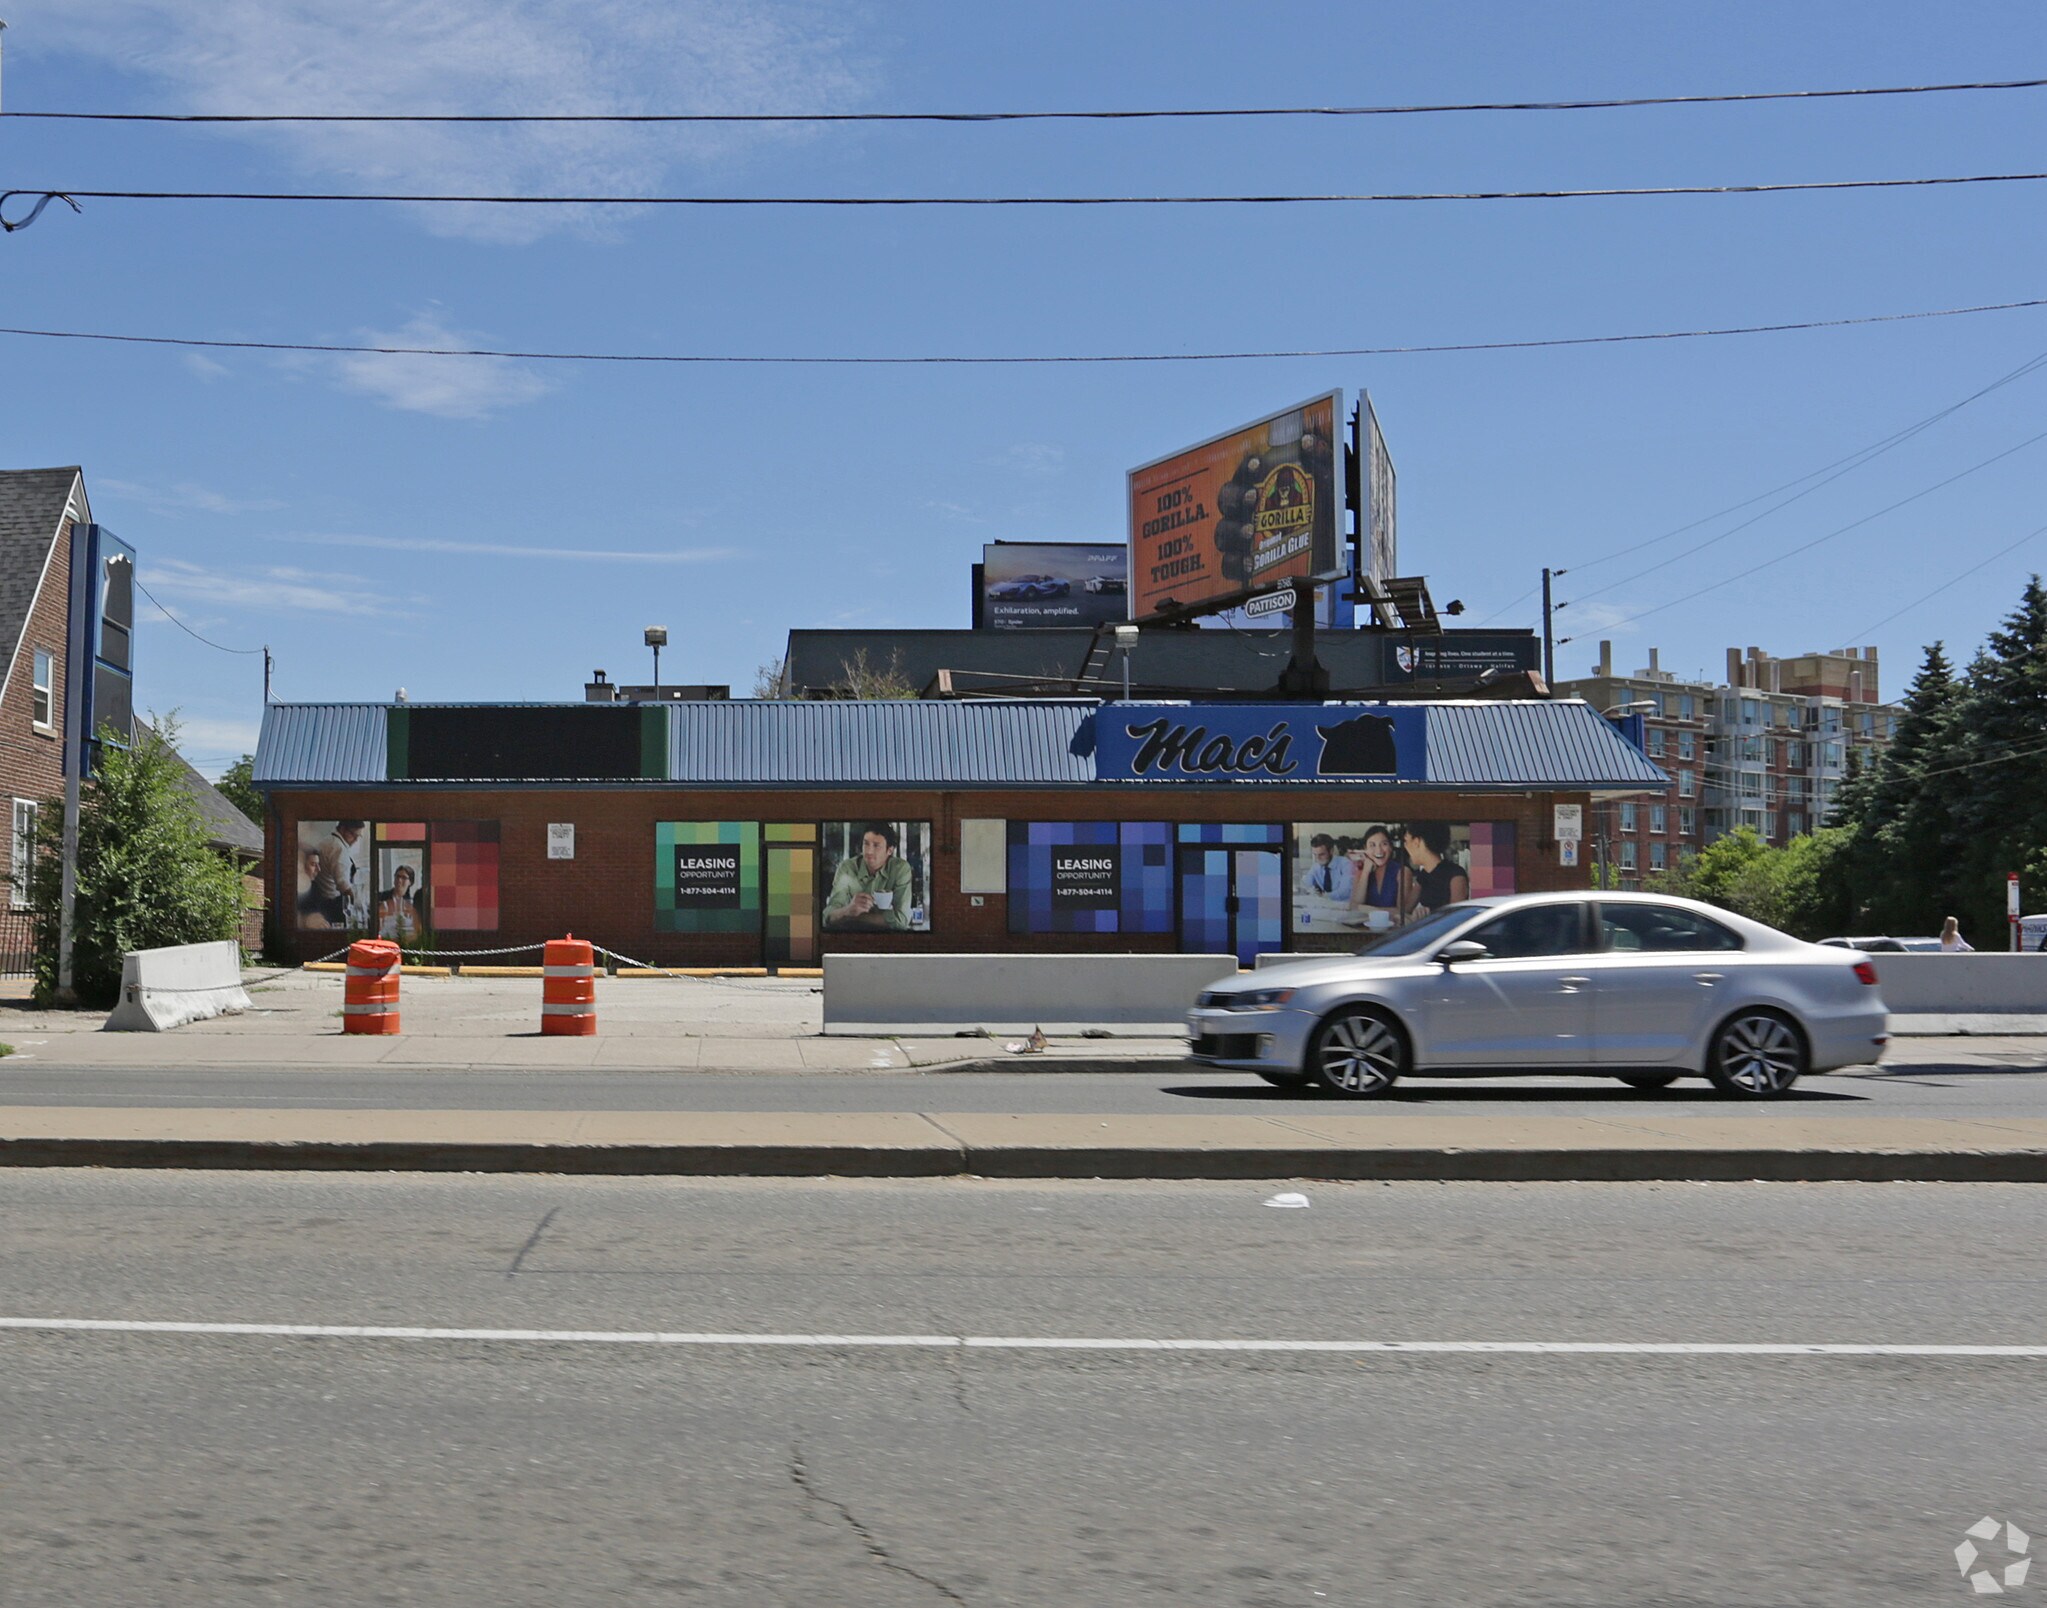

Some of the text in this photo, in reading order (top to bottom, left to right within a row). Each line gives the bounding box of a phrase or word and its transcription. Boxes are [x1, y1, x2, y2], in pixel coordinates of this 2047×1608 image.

[1157, 485, 1193, 513] 100%
[1142, 503, 1209, 539] GORILLA.
[1261, 508, 1304, 528] GORILLA
[1158, 534, 1193, 560] 100%
[1287, 532, 1310, 554] GLUE
[1151, 553, 1205, 583] TOUGH.
[994, 607, 1079, 616] Exhilaration, amplified.
[1249, 594, 1293, 614] PATTISON
[1126, 716, 1299, 777] Mac's
[680, 858, 736, 869] LEASING
[1057, 859, 1112, 870] LEASING
[680, 871, 735, 879] OPPORTUNITY
[1057, 872, 1112, 880] OPPORTUNITY
[680, 887, 736, 895] 1-877-504-4114
[1057, 888, 1113, 896] 1-877-504-4114
